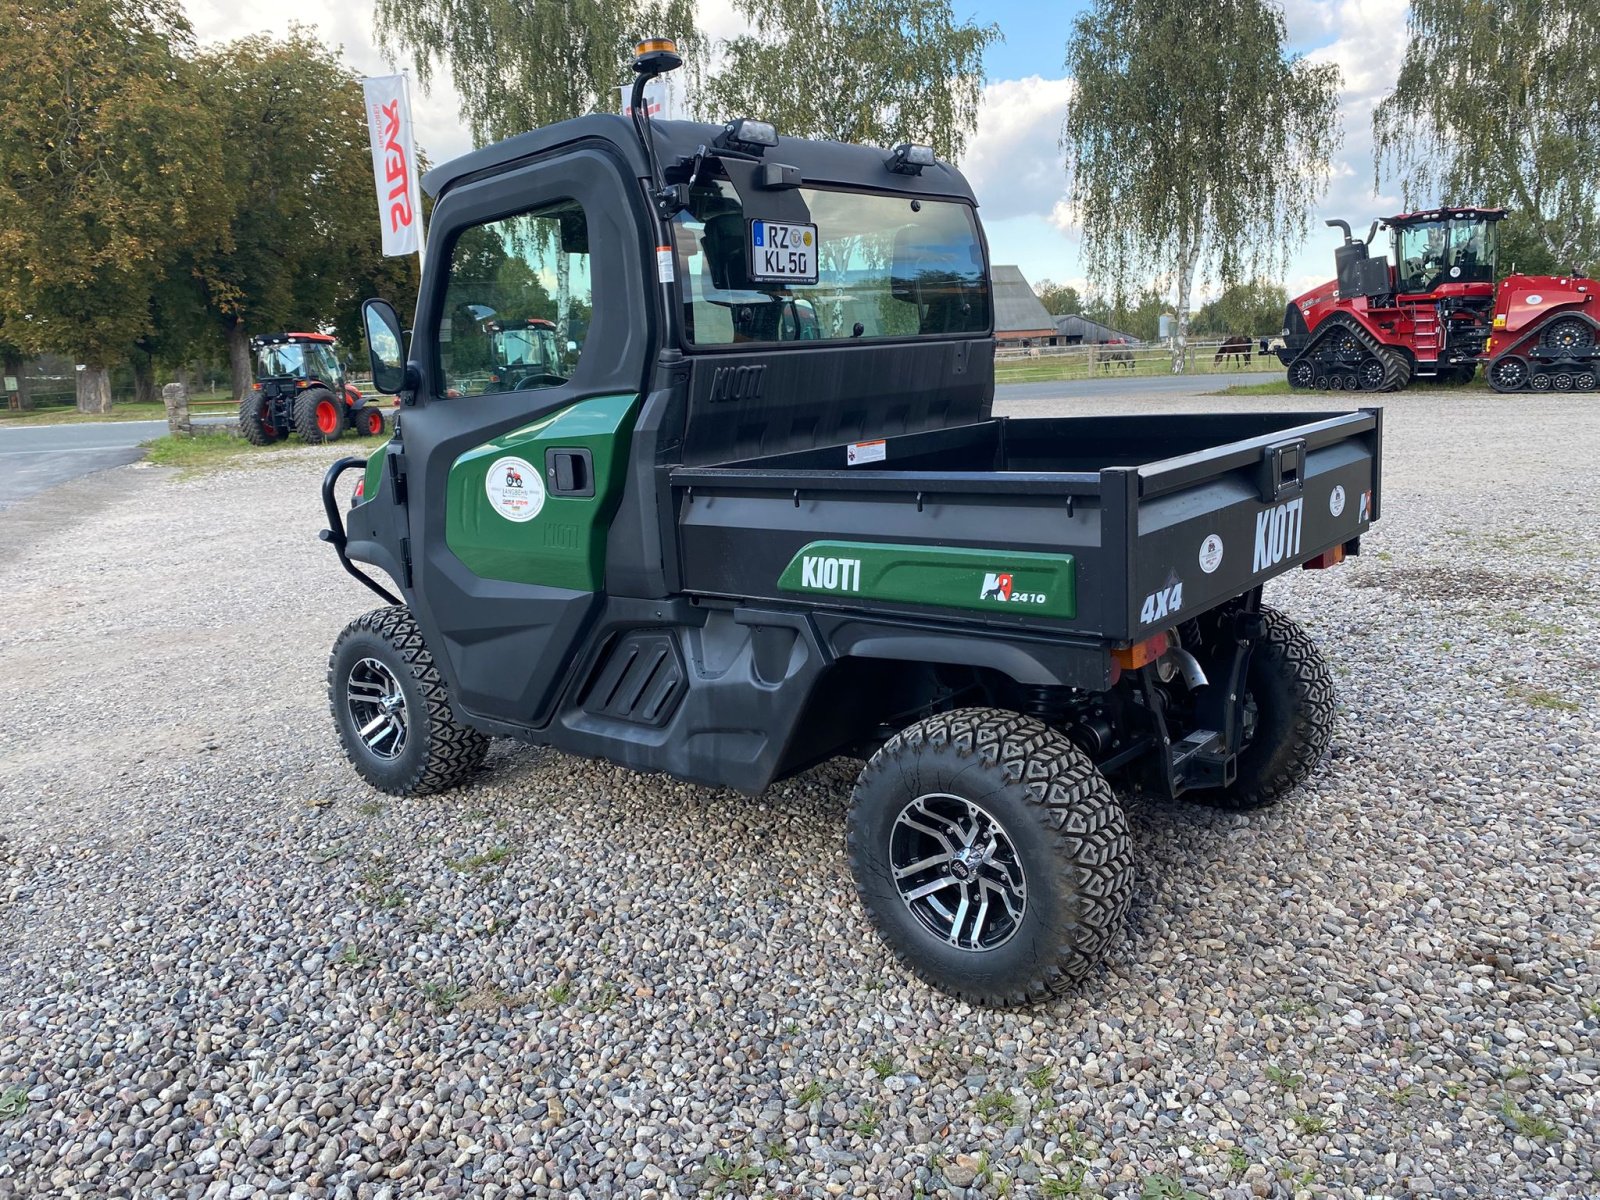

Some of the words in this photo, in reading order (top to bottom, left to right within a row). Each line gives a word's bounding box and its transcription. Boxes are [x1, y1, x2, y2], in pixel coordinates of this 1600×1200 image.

[768, 225, 789, 249] RZ
[765, 249, 785, 273] KL
[788, 251, 807, 274] 50
[709, 364, 767, 402] KIOTI
[543, 522, 580, 549] KIOTI
[1252, 497, 1304, 574] KIOTI
[801, 556, 861, 592] KIOTI
[1010, 592, 1046, 604] 2410
[1139, 582, 1183, 625] 4X4
